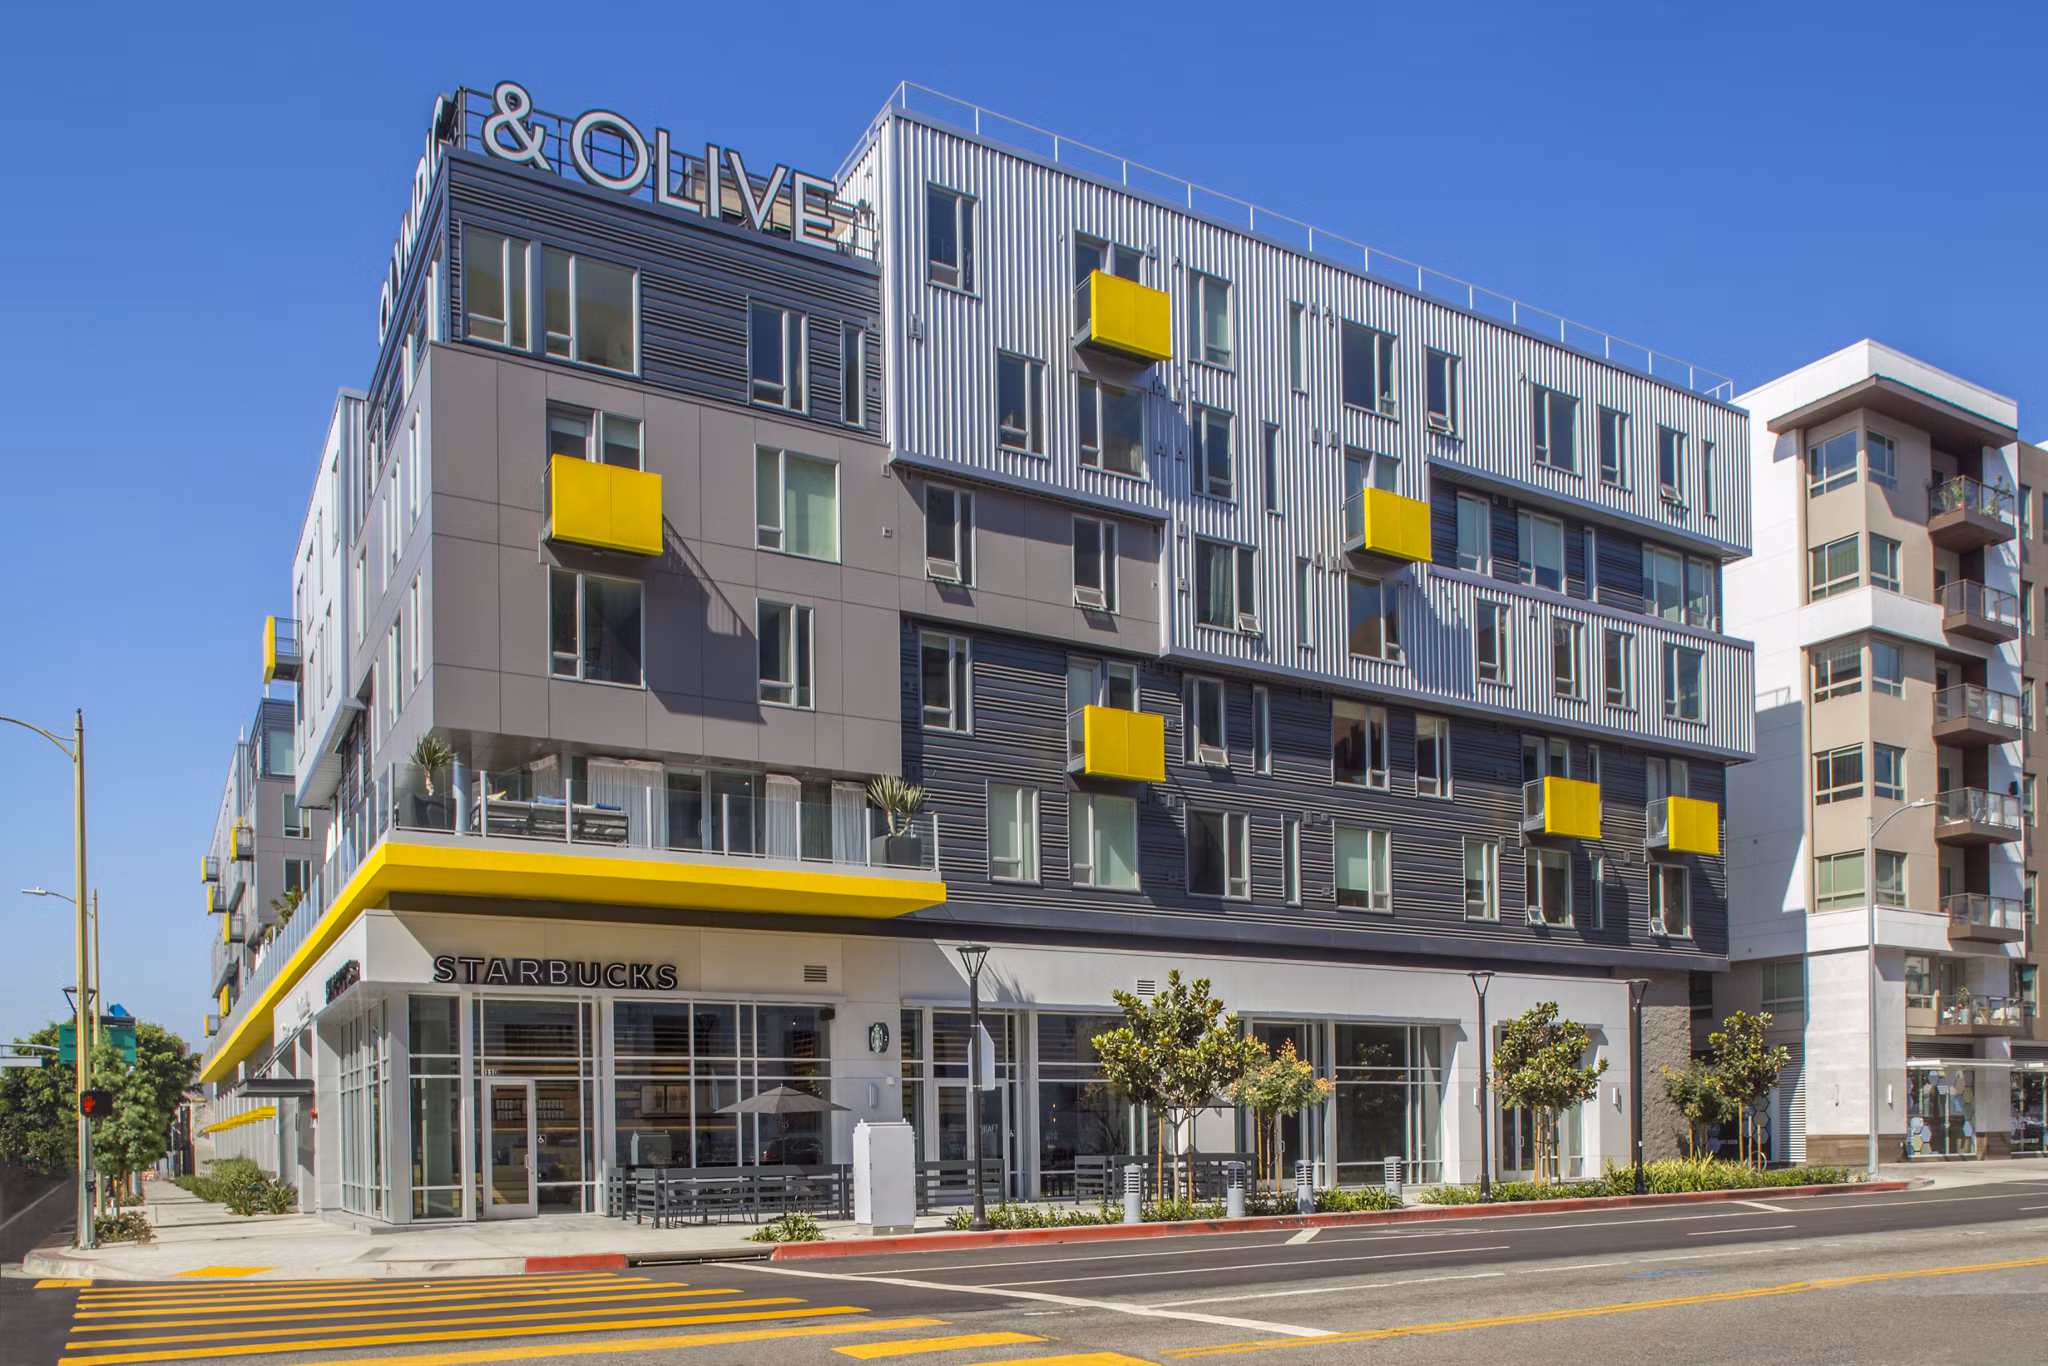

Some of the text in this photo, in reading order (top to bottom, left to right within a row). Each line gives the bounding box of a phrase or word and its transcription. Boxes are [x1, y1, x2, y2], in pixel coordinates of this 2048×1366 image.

[379, 94, 448, 347] OLYMPIC
[481, 80, 838, 251] & OLIVE
[433, 955, 678, 990] STARBUCKS
